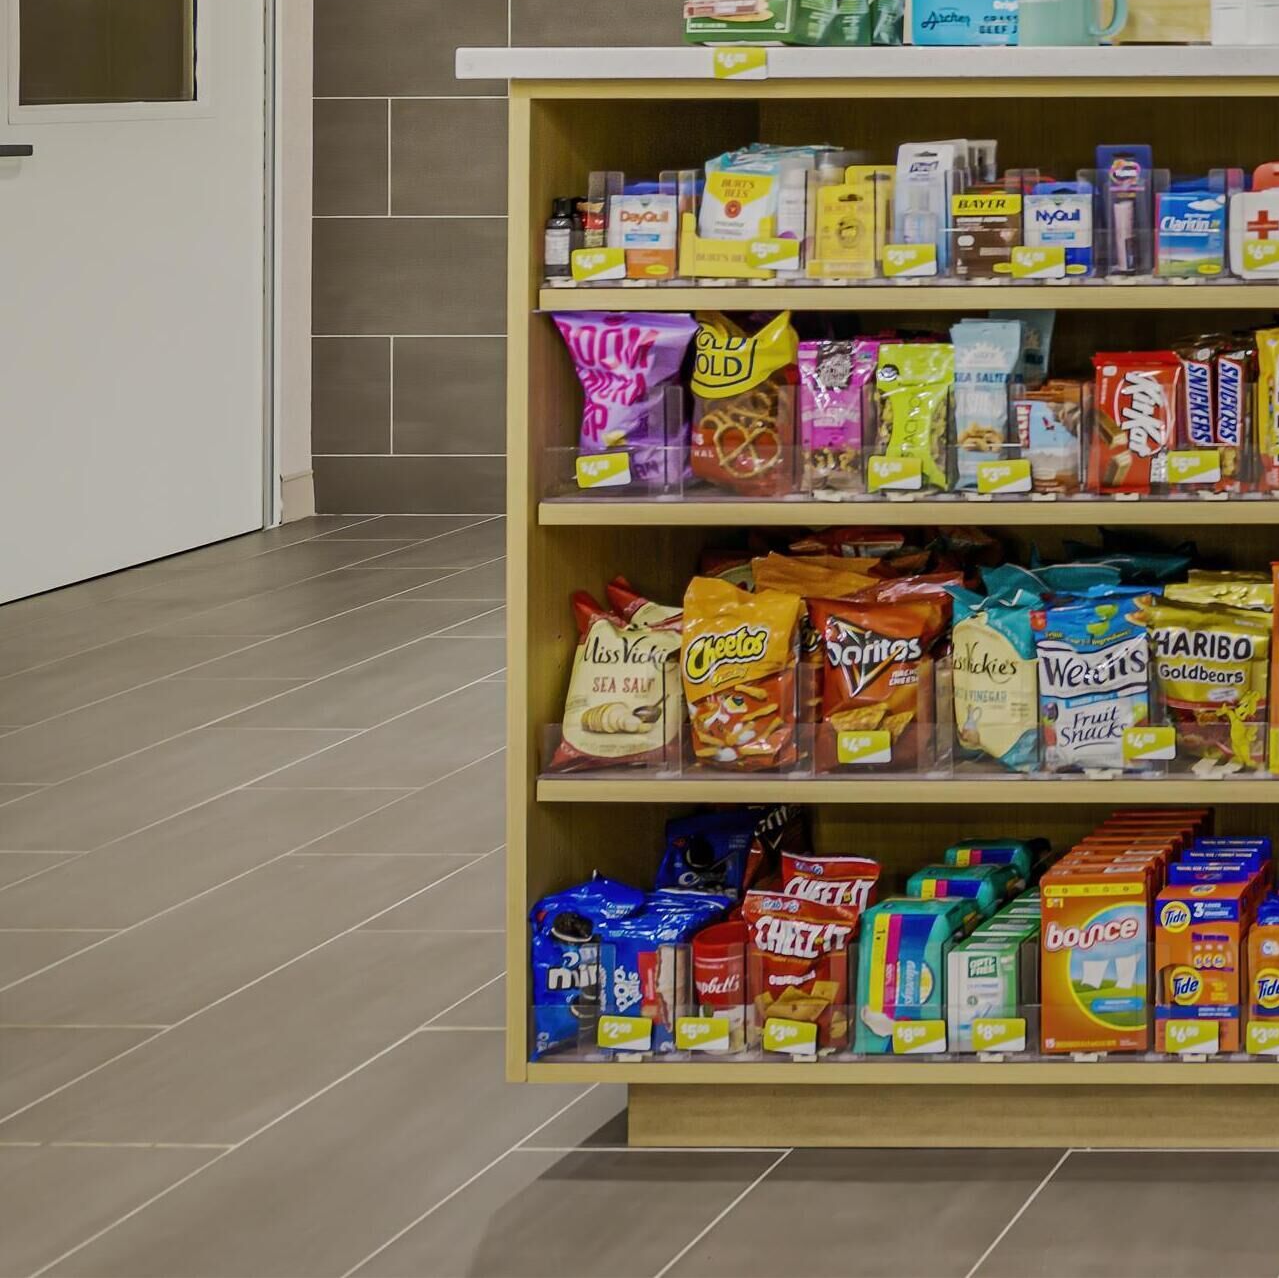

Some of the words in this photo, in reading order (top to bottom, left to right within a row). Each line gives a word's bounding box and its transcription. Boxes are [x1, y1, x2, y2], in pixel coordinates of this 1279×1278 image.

[620, 210, 669, 225] DayQuil
[1036, 209, 1081, 225] NyQuil
[695, 354, 742, 377] OLD
[1187, 363, 1213, 444] SNICKERS
[1218, 362, 1240, 445] SNICKERS
[686, 626, 770, 683] Cheetos
[826, 636, 922, 667] Doritos
[1156, 631, 1253, 661] HARIBO
[1040, 646, 1146, 689] Welch's
[1159, 664, 1245, 685] Goldbears
[592, 677, 616, 693] SEA
[622, 677, 655, 693] SALT
[1072, 706, 1120, 728] Fruit
[1059, 724, 1127, 746] Snacks
[1163, 910, 1187, 926] Tide
[1045, 917, 1139, 952] bounce
[1173, 975, 1199, 997] Tide
